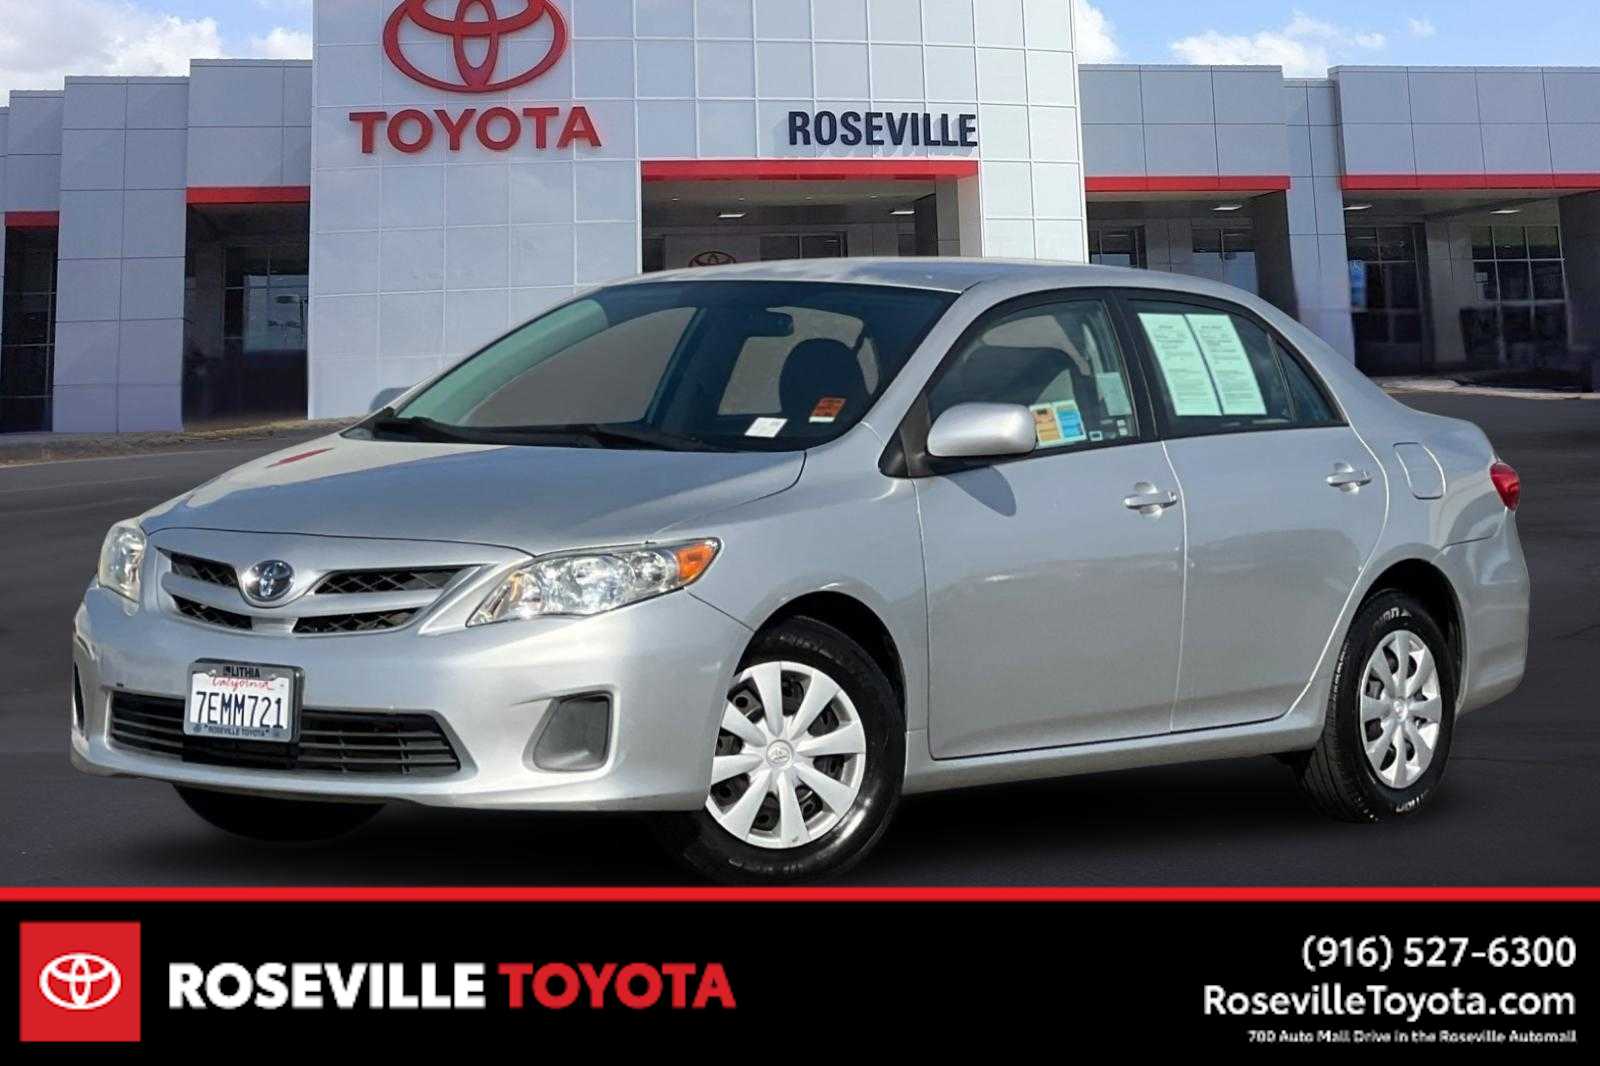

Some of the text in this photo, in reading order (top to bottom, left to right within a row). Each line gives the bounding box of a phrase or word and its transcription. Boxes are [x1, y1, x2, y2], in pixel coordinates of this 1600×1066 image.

[349, 106, 602, 153] TOYOTA
[788, 110, 978, 147] ROSEVILLE
[231, 665, 260, 677] LITHIA
[211, 677, 275, 691] California
[196, 691, 284, 729] 7EMM721
[208, 725, 265, 737] ROSEVILLE TOYOTA
